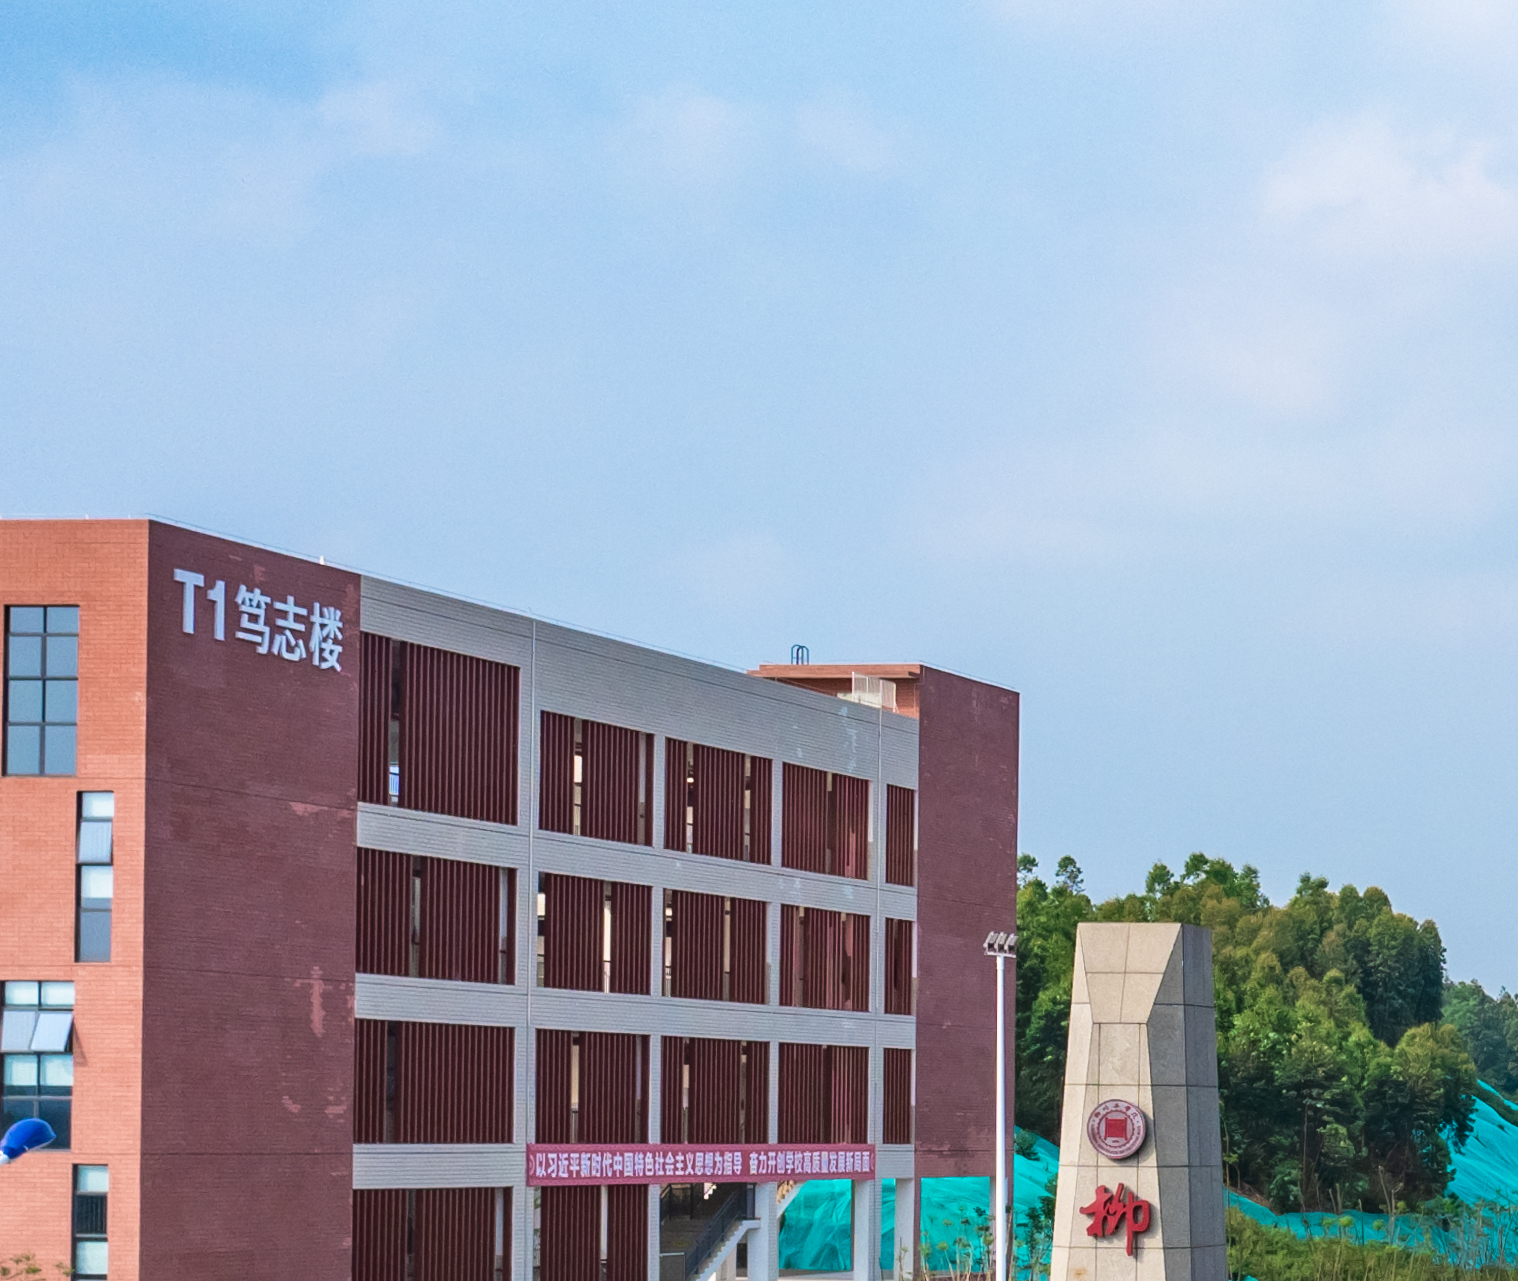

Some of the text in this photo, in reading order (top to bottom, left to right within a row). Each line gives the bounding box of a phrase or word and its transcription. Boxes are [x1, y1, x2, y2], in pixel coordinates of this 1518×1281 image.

[173, 568, 343, 672] T1笃志楼
[535, 1151, 870, 1178] 以习近平新时代中国特色社会主义思想为指导 奋力开创学校高质量发展新局面
